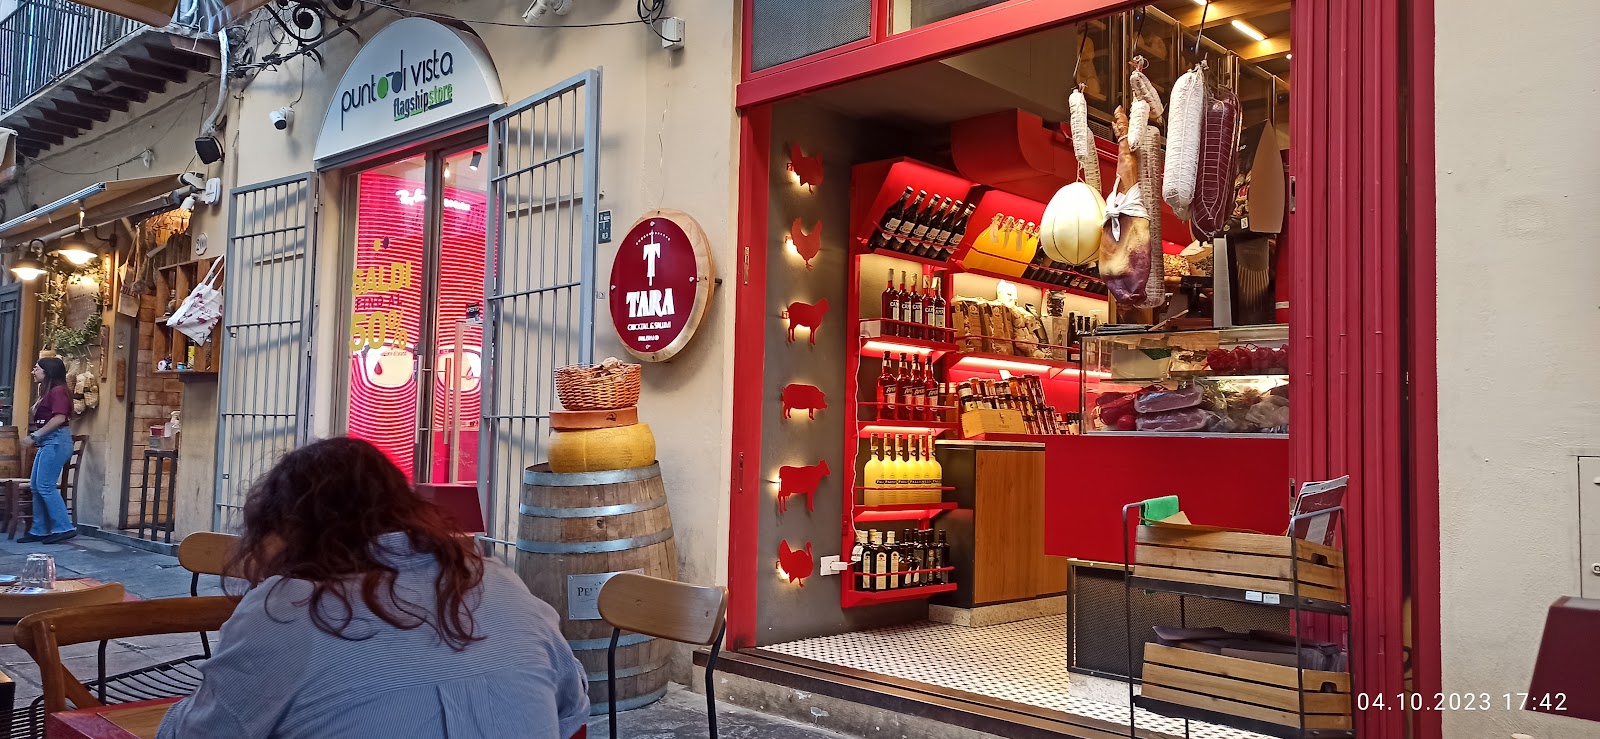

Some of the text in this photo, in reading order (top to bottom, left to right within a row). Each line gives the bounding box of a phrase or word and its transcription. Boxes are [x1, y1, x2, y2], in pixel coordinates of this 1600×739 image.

[409, 49, 453, 87] vista
[351, 261, 411, 295] SALDI
[355, 294, 403, 310] FINO AL
[626, 288, 675, 318] TARA
[349, 309, 408, 351] 50%
